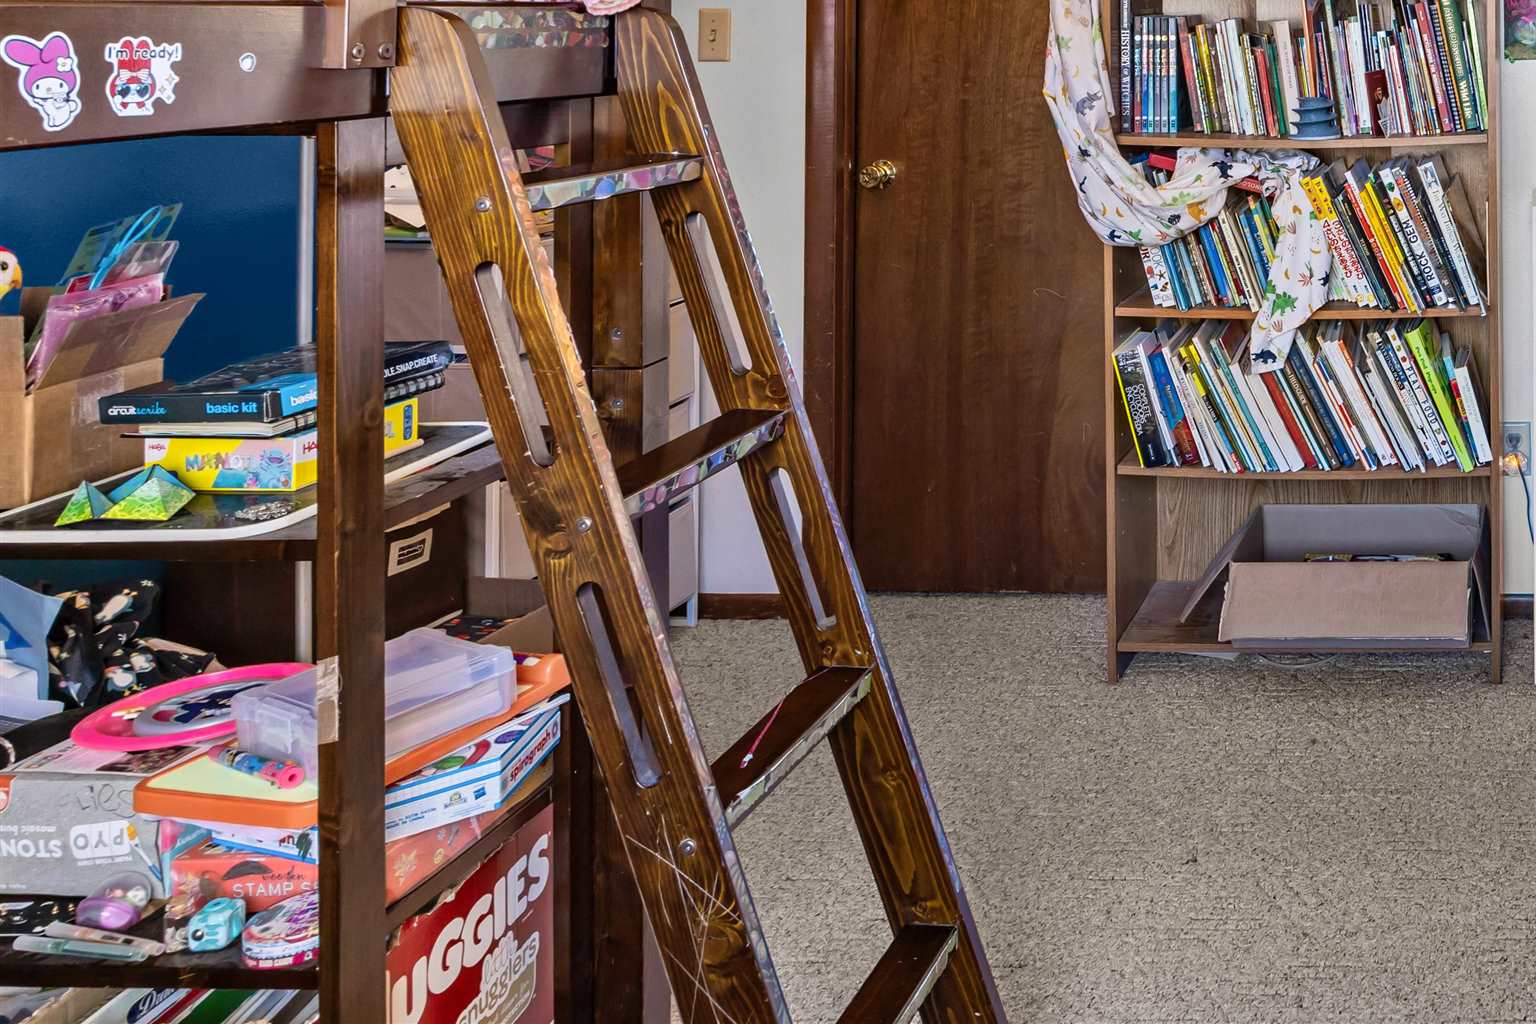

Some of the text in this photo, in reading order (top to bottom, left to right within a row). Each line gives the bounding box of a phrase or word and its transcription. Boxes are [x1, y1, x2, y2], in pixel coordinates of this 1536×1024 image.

[107, 45, 179, 62] I'm ready!
[1121, 29, 1131, 66] HISTORY
[1121, 75, 1131, 116] WITCHES
[1401, 218, 1436, 282] ROCK GEM
[206, 403, 239, 414] basic
[241, 402, 258, 414] kit
[1125, 386, 1144, 437] ENCYCLOPEDIA
[1131, 385, 1147, 425] OUTDOORS
[1137, 383, 1152, 420] COMPLETE
[1405, 366, 1437, 425] PLAY FOOD
[509, 728, 551, 784] spirograph
[21, 825, 56, 835] mosaic
[73, 828, 125, 851] PYO
[232, 882, 294, 898] STAMP
[386, 832, 550, 1024] UGGIES
